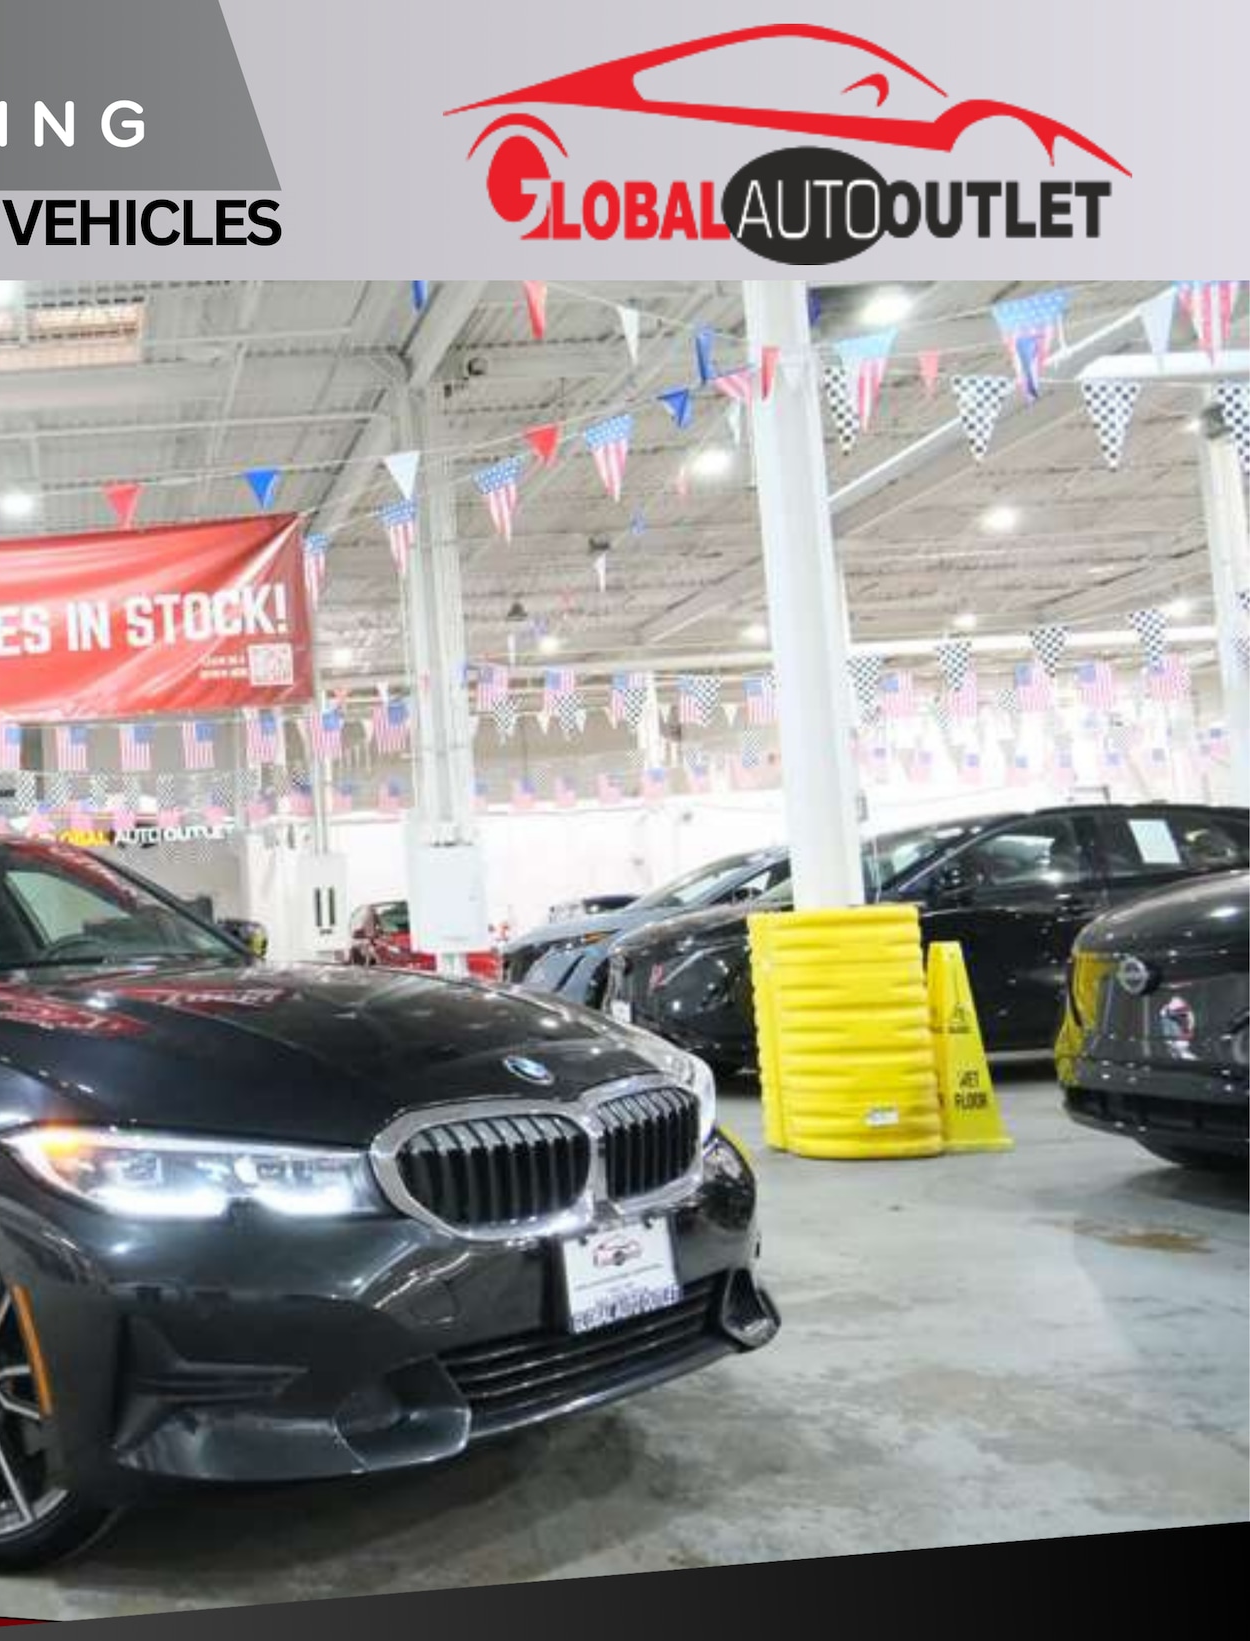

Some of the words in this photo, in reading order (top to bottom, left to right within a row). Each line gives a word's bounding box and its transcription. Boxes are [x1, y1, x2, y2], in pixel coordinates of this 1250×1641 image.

[66, 600, 112, 651] IN
[125, 584, 289, 648] STOCK!
[114, 827, 160, 844] AUTO
